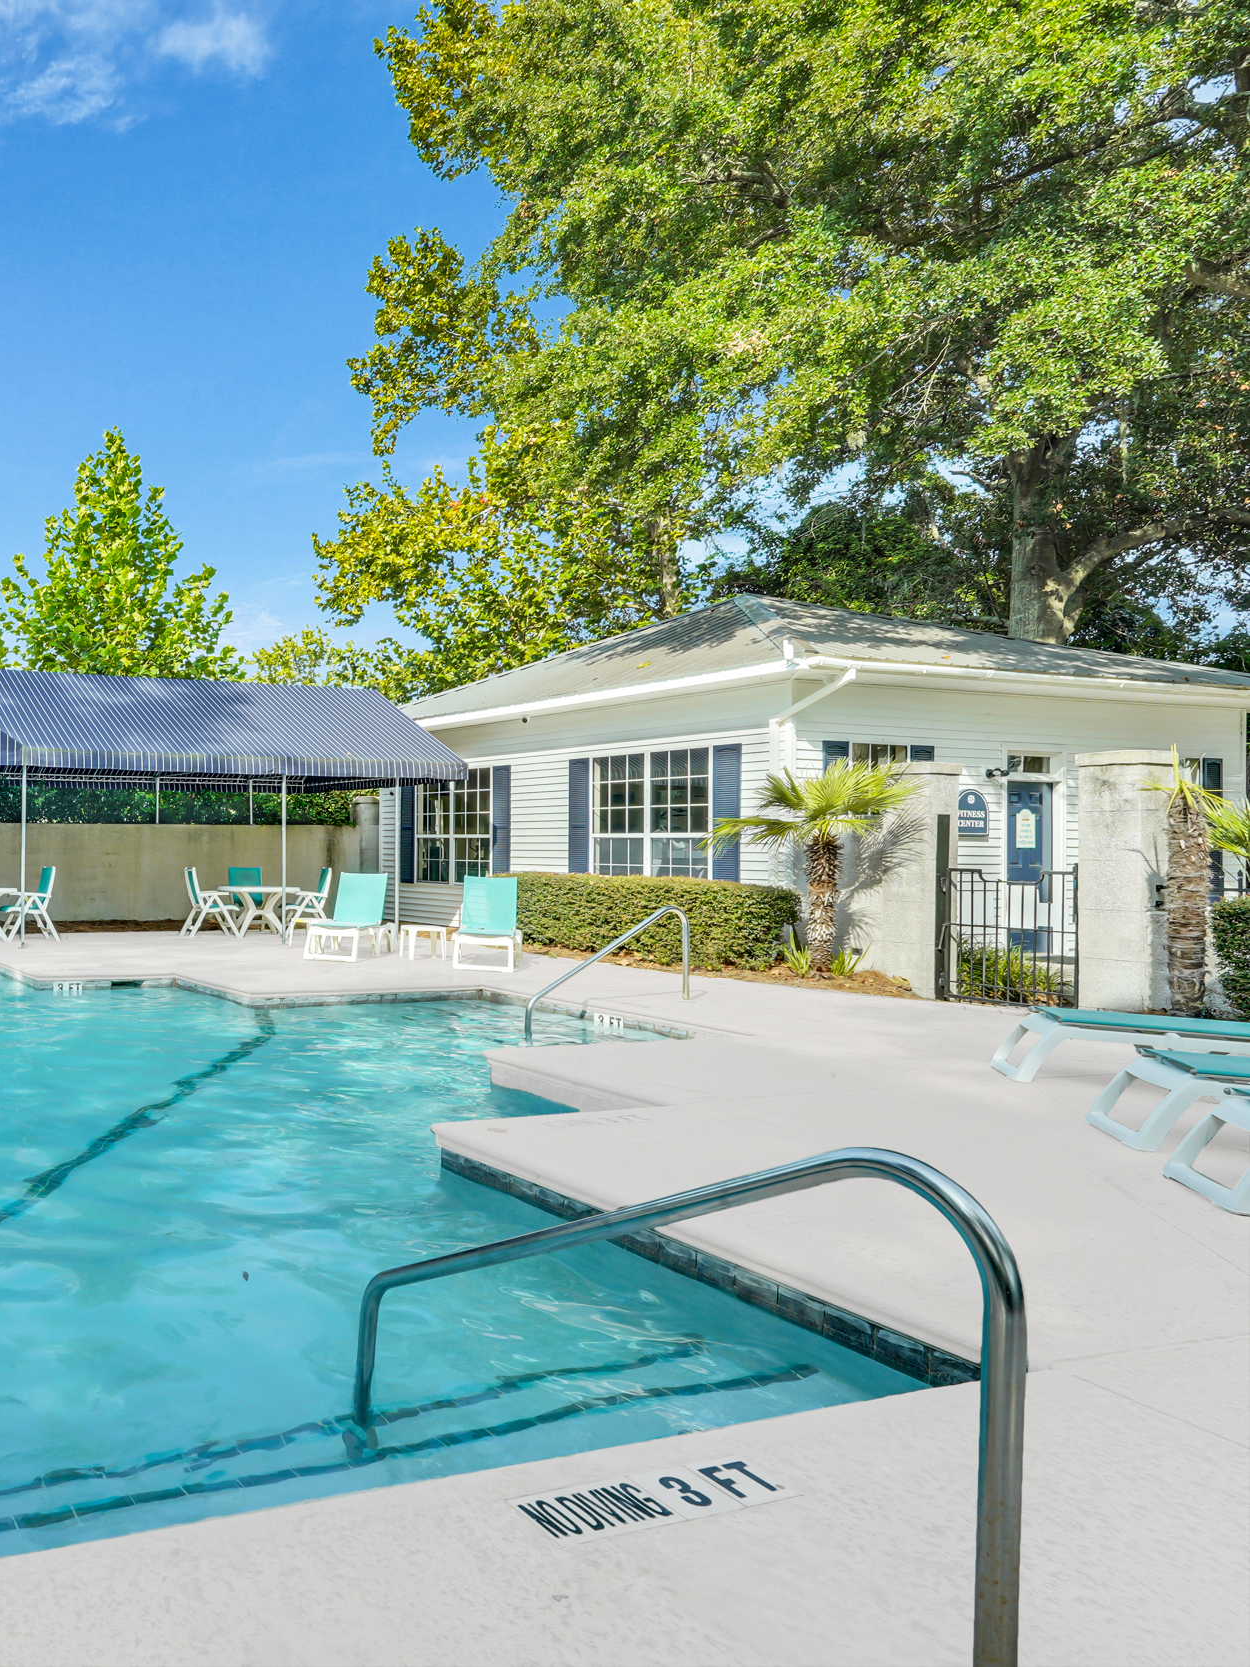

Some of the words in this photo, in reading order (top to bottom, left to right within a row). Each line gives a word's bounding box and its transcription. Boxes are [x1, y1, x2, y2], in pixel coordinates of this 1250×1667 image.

[957, 809, 986, 819] FITNESS
[958, 820, 985, 828] CENTER
[517, 1500, 583, 1539] NO
[554, 1483, 674, 1531] DIVING
[658, 1476, 713, 1507] 3
